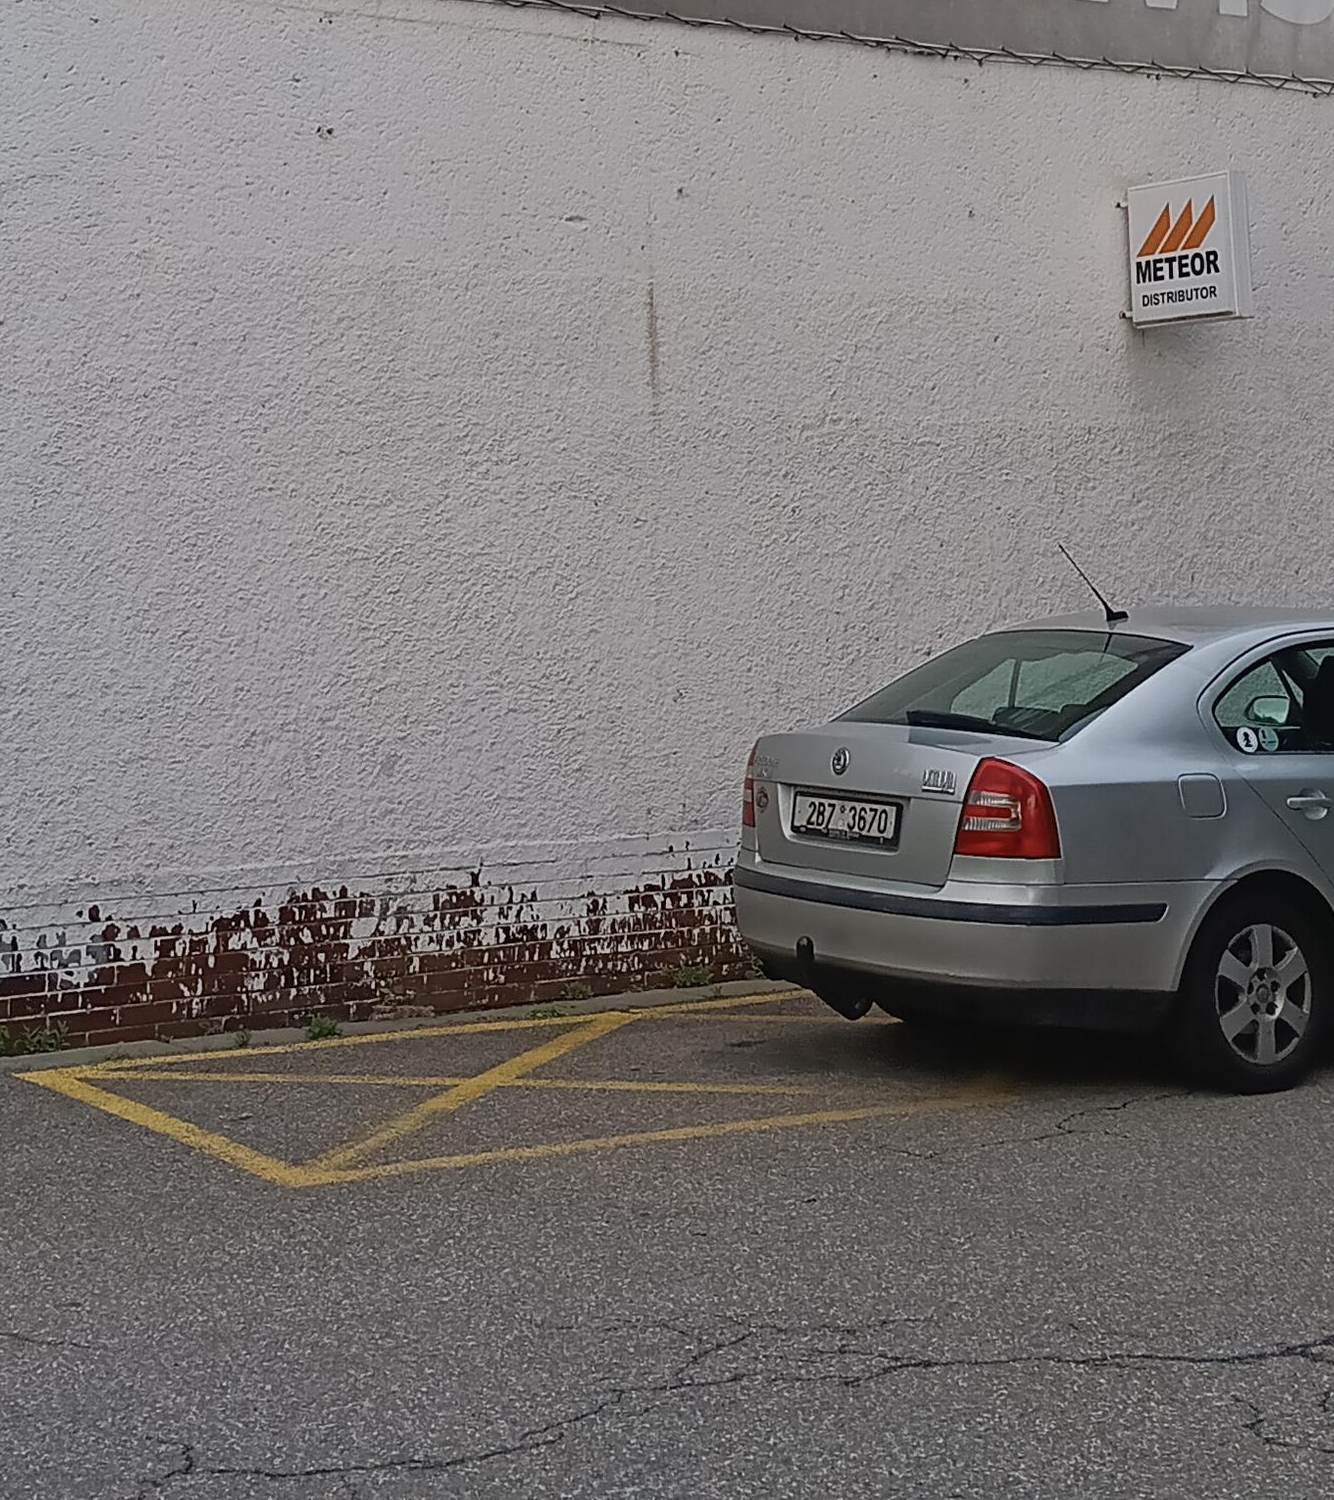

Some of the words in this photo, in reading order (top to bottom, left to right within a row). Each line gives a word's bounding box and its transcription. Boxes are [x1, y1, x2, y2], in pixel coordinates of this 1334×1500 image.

[1136, 250, 1220, 284] METEOR
[1142, 285, 1217, 307] DISTRIBUTOR
[806, 801, 836, 830] 2B7
[847, 806, 888, 834] 3670
